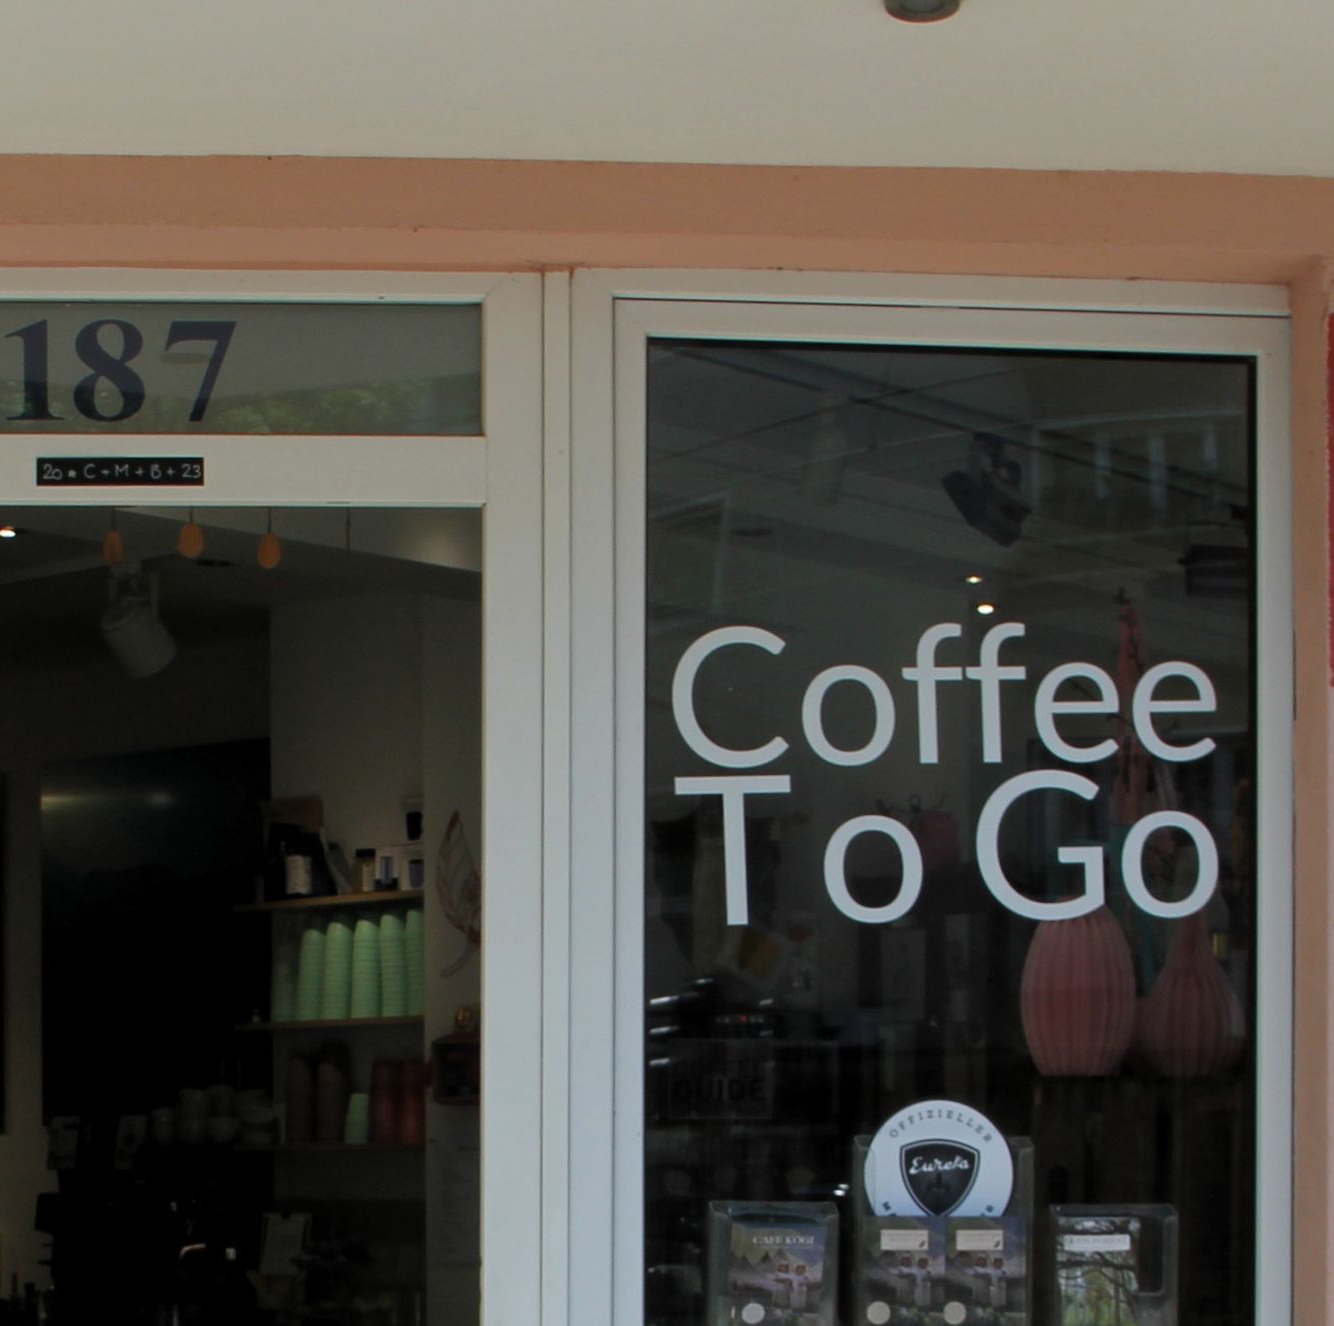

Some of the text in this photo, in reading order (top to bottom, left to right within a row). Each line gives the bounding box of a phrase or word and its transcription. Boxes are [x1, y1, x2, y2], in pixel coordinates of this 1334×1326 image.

[5, 319, 237, 422] 187
[672, 622, 1217, 767] Coffee
[674, 769, 1219, 925] To Go
[889, 1109, 993, 1143] OFFIZIELLER
